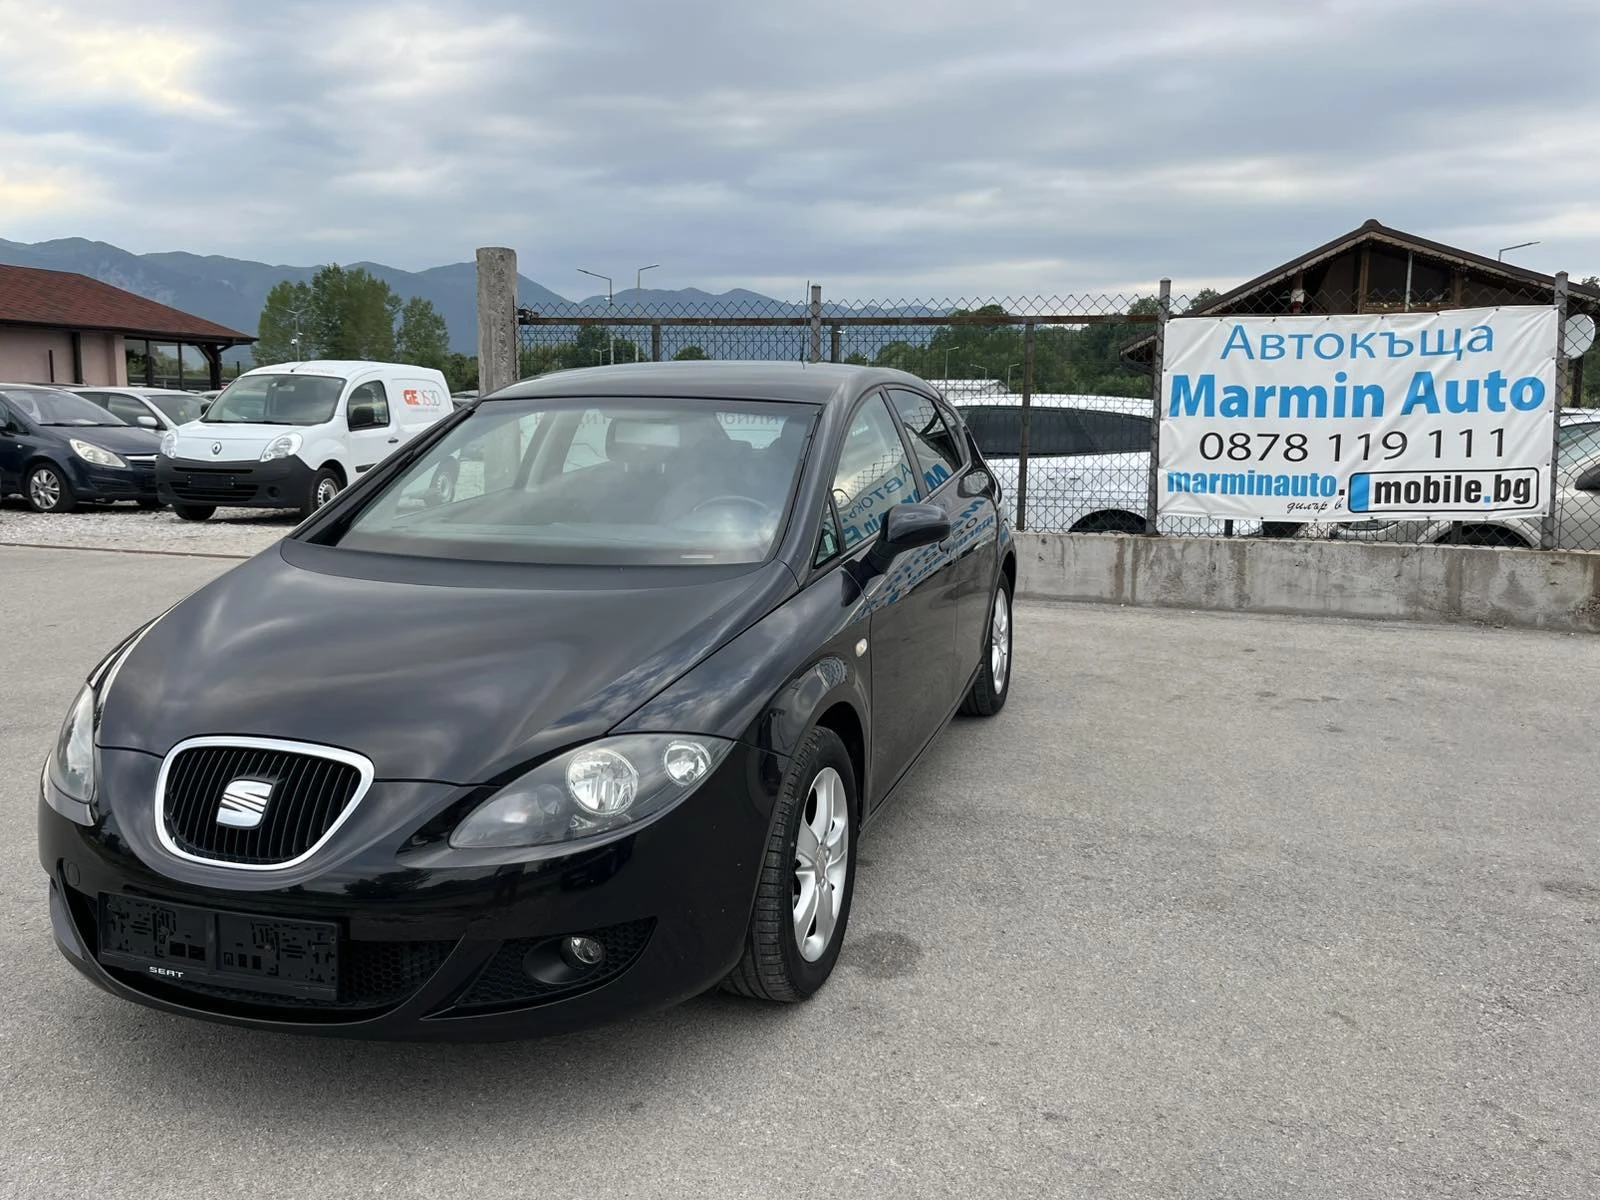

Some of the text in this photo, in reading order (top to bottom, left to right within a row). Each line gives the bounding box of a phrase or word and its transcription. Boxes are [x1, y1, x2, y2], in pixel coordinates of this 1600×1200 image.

[1169, 369, 1546, 419] Marmin Auto
[1199, 428, 1504, 462] 0878 119 111
[1374, 474, 1531, 505] mobile.bg
[149, 966, 184, 978] SEAT
